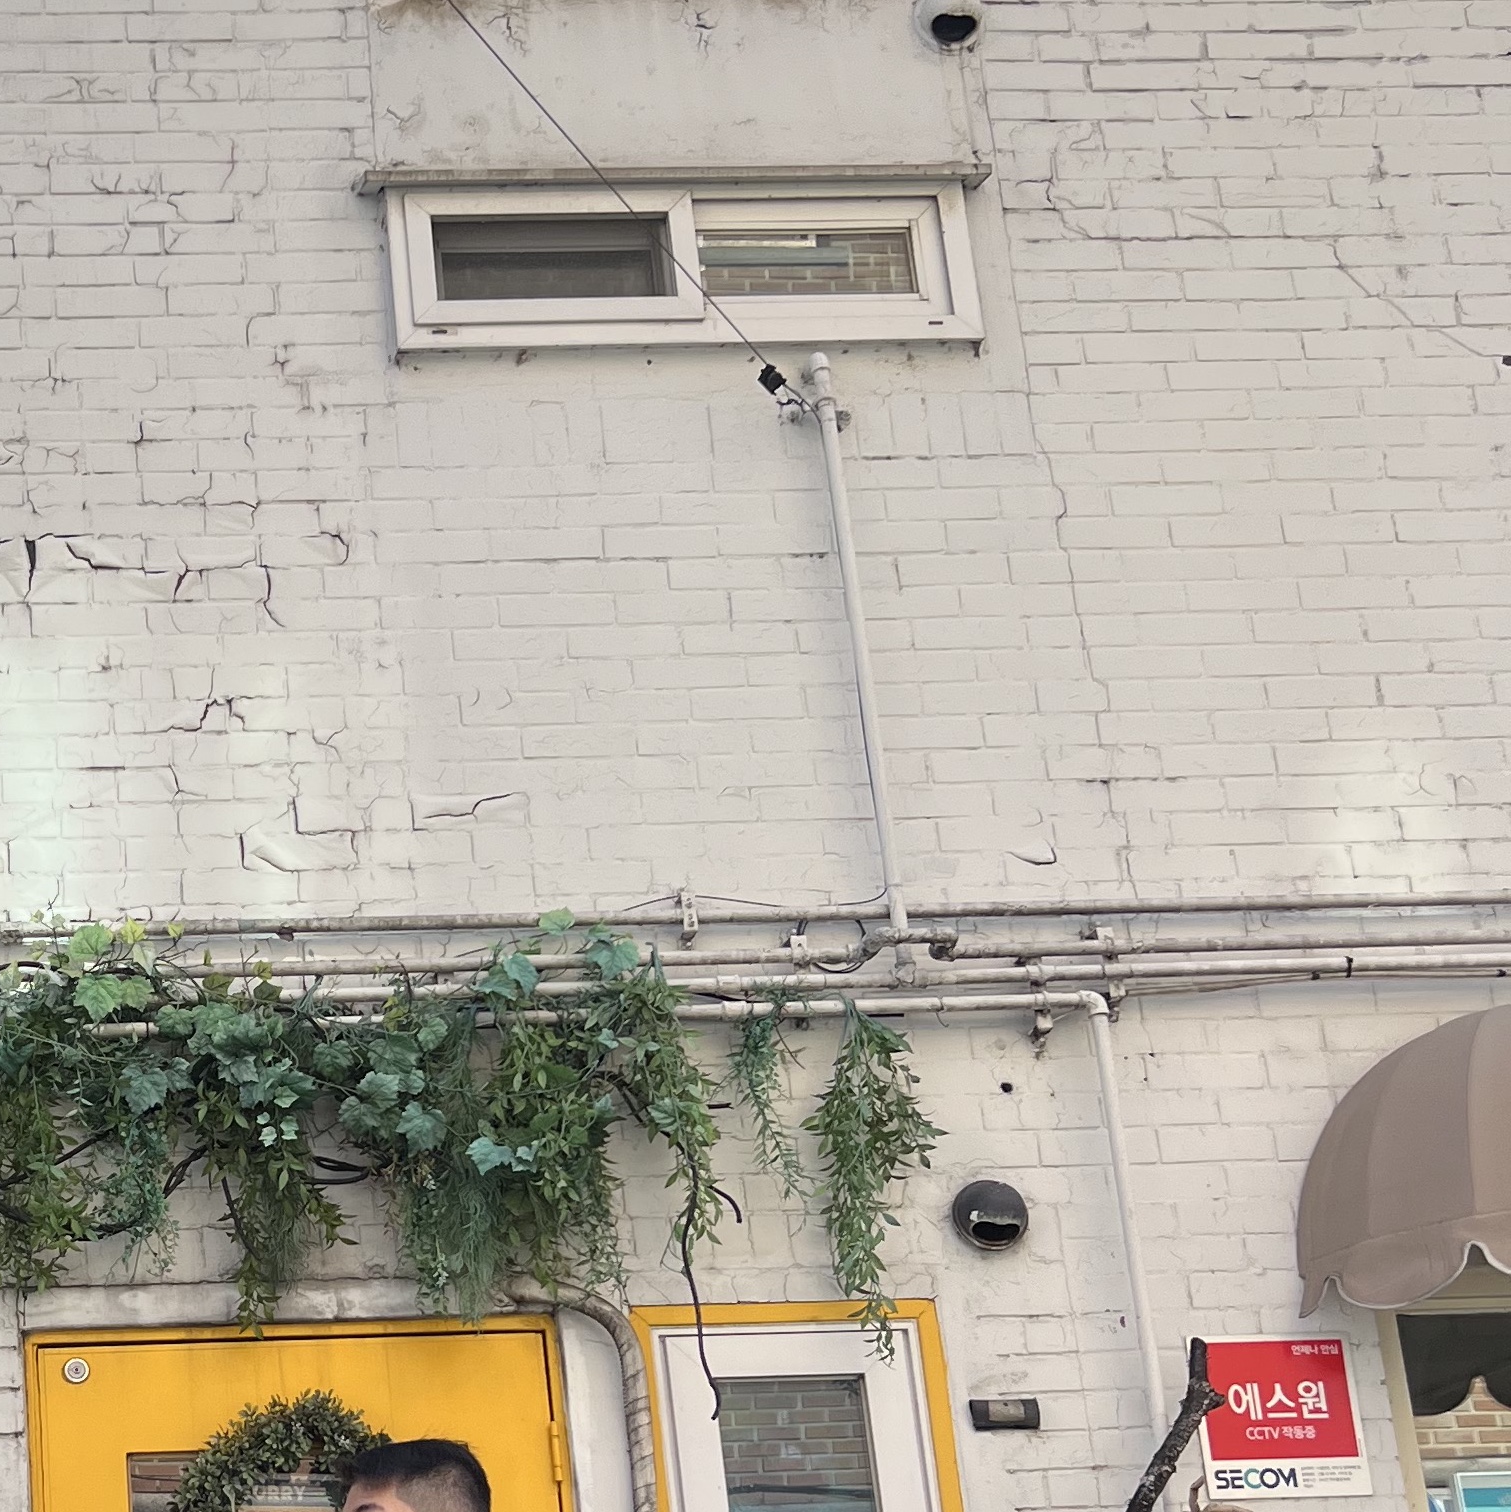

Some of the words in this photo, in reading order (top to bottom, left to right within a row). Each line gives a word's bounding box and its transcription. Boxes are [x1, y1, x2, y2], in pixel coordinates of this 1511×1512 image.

[1227, 1380, 1330, 1421] 에스원
[1246, 1426, 1280, 1440] CCTV
[1282, 1425, 1317, 1440] 작동중
[1213, 1467, 1299, 1489] SECOM
